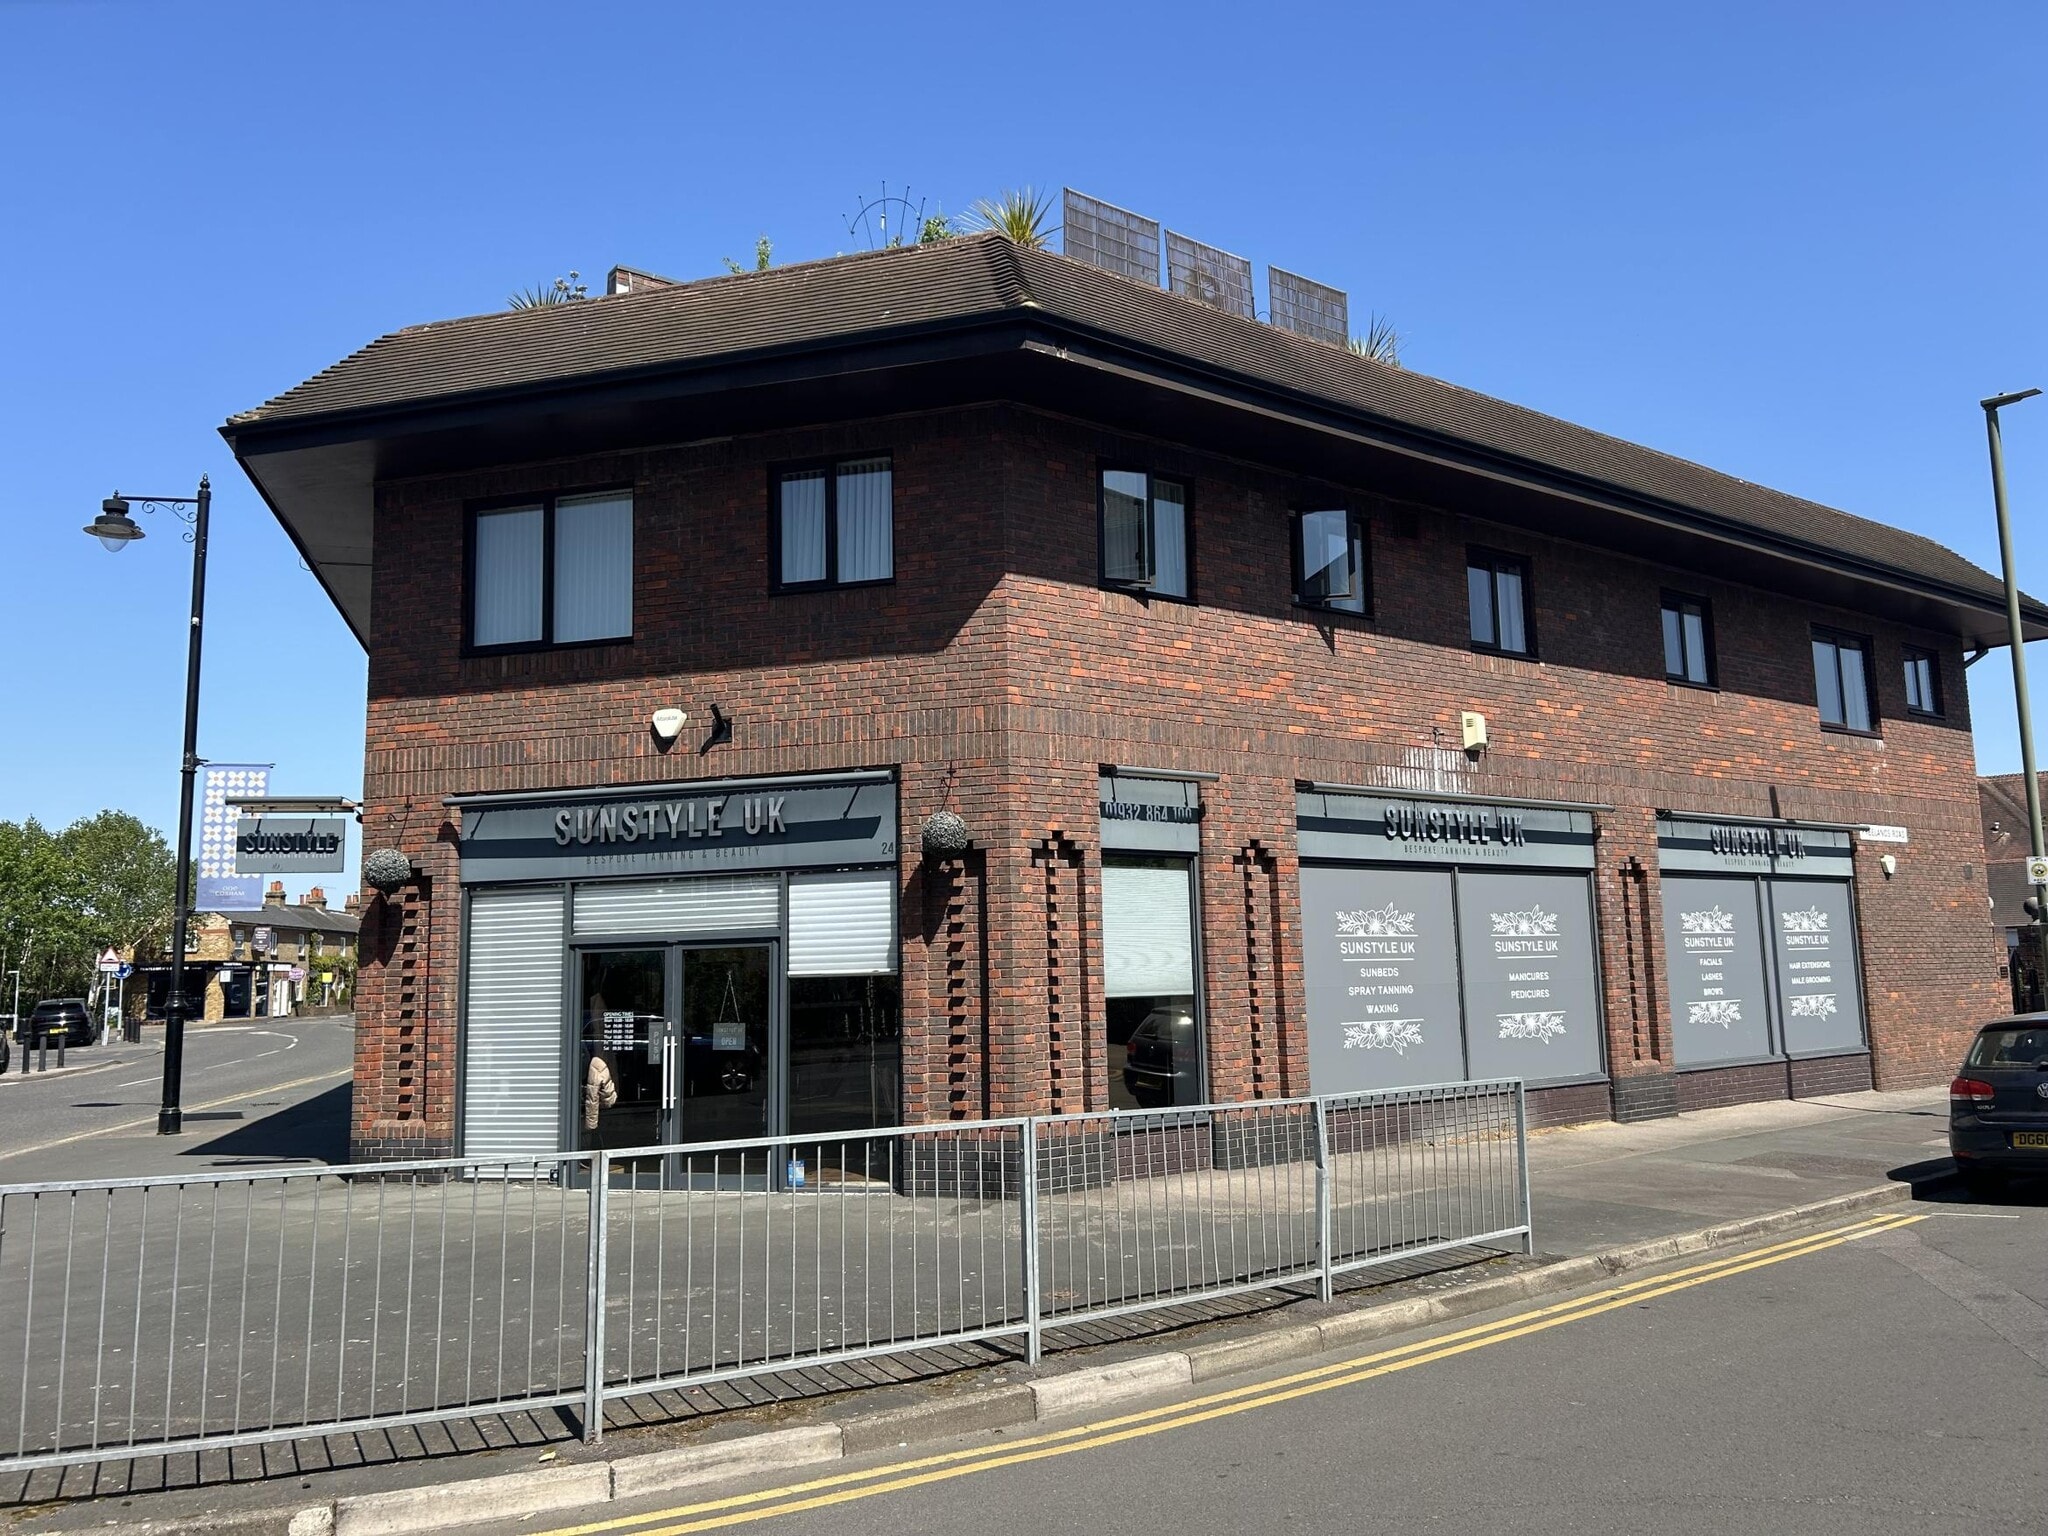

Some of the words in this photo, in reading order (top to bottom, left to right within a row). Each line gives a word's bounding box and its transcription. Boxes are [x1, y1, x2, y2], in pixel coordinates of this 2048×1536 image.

[1105, 802, 1141, 821] 01932
[1146, 805, 1168, 822] 864
[554, 800, 723, 845] SUNSTYLE
[744, 796, 786, 835] UK
[1385, 804, 1490, 844] SUNSTYLE
[1500, 813, 1526, 845] UK
[1864, 828, 1891, 838] EELANDS
[245, 832, 335, 851] SUNSTYLE
[1711, 825, 1782, 855] SUNSTYLE
[1788, 830, 1806, 857] UK
[881, 841, 895, 855] 24
[1404, 845, 1437, 855] BESPOKE
[1440, 846, 1472, 856] TANNING
[1483, 848, 1509, 857] BEAUTY
[586, 853, 637, 865] BESPOKE
[645, 850, 694, 862] TANNING
[702, 848, 708, 858] &
[715, 846, 762, 858] BEAUTY
[1684, 937, 1723, 948] SUNSTYLE
[1723, 936, 1734, 947] UK
[1785, 935, 1820, 945] SUNSTYLE
[1820, 935, 1830, 944] UK
[1340, 941, 1398, 954] SUNSTYLE
[1400, 941, 1416, 954] UK
[1495, 941, 1544, 953] SUNSTYLE
[1545, 940, 1559, 951] UK
[1700, 958, 1723, 966] FACIALS
[1360, 968, 1399, 978] SUNBEDS
[1508, 972, 1549, 982] MANICURES
[1701, 973, 1723, 981] LASHES
[1348, 986, 1377, 996] SPRAY
[1378, 985, 1414, 995] TANNING
[1511, 989, 1550, 999] PEDICURES
[1703, 987, 1724, 996] BROWS
[1366, 1004, 1399, 1014] WAXING
